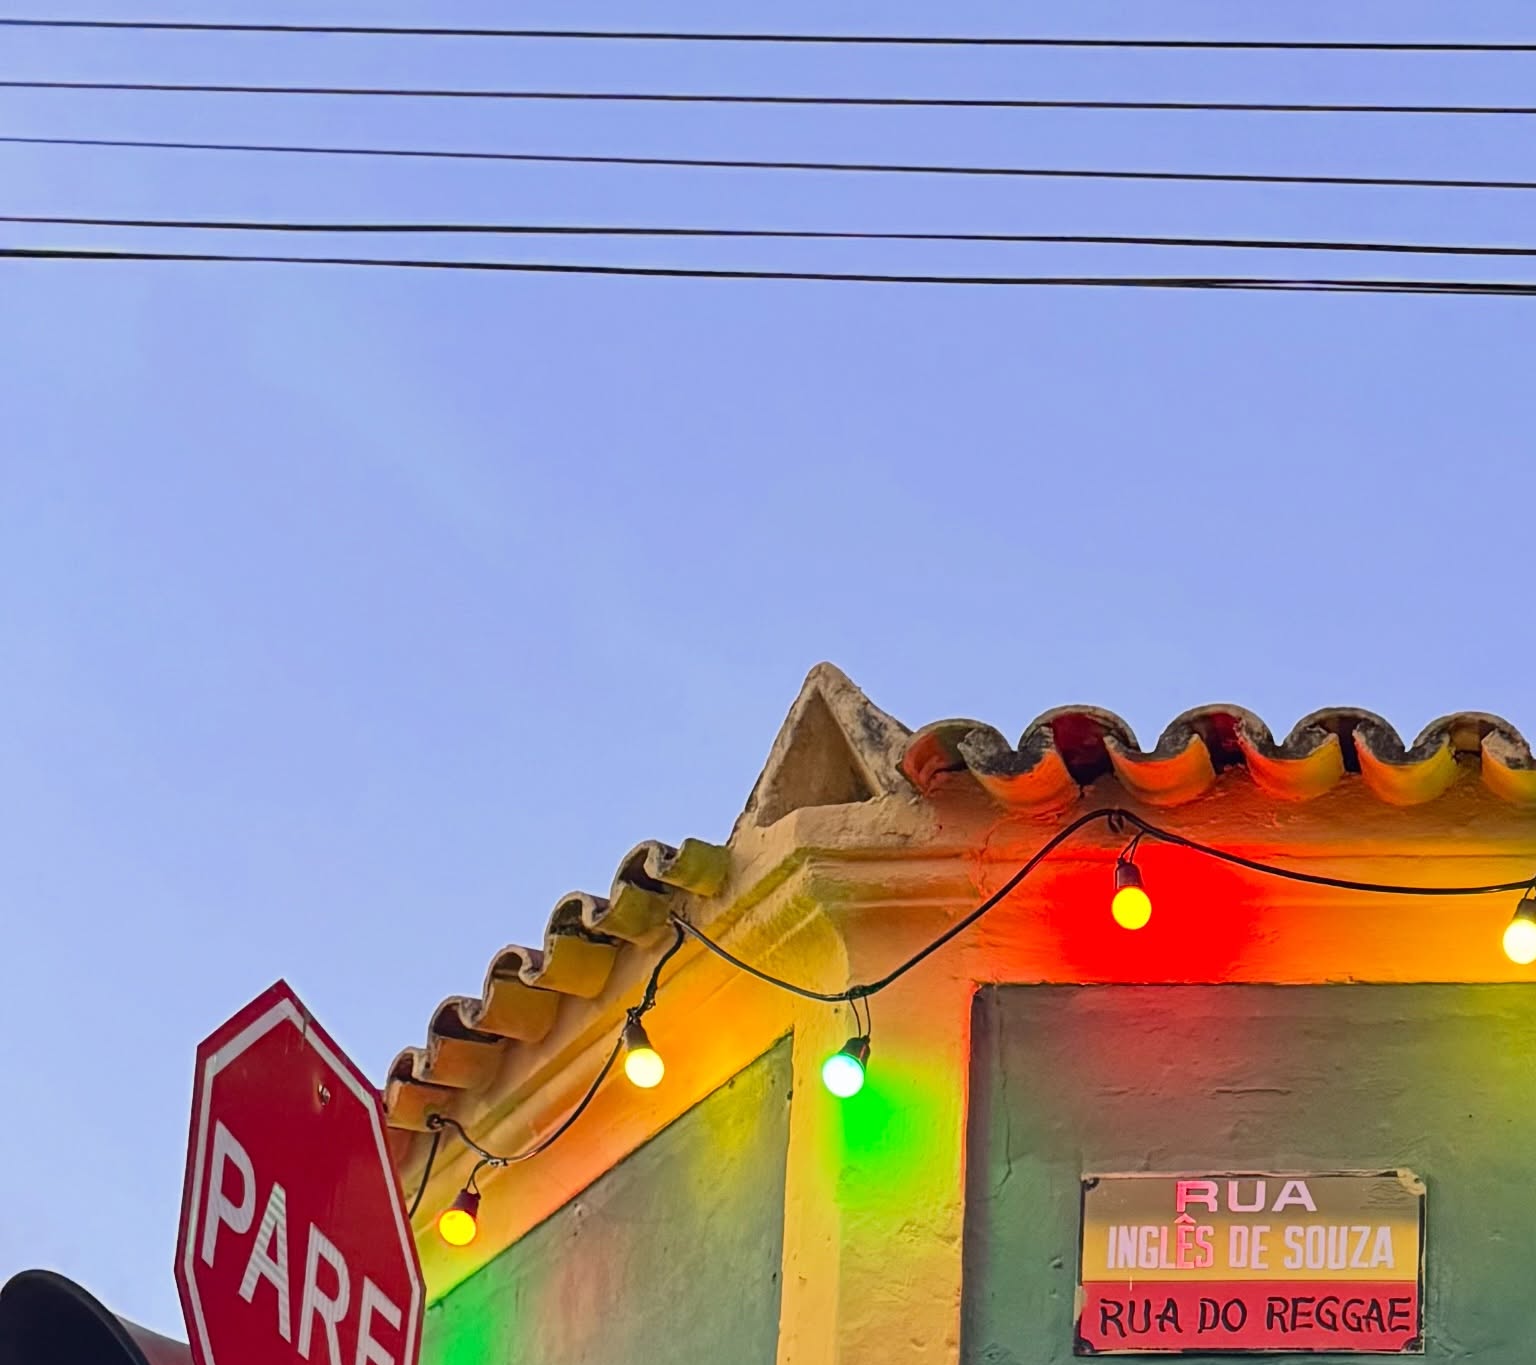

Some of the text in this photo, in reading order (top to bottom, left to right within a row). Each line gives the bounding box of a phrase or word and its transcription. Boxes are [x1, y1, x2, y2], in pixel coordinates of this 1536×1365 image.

[1175, 1180, 1318, 1213] RUA
[1106, 1213, 1395, 1270] INGLÊS DE SOUZA
[1100, 1296, 1412, 1338] RUA DO REGGAE
